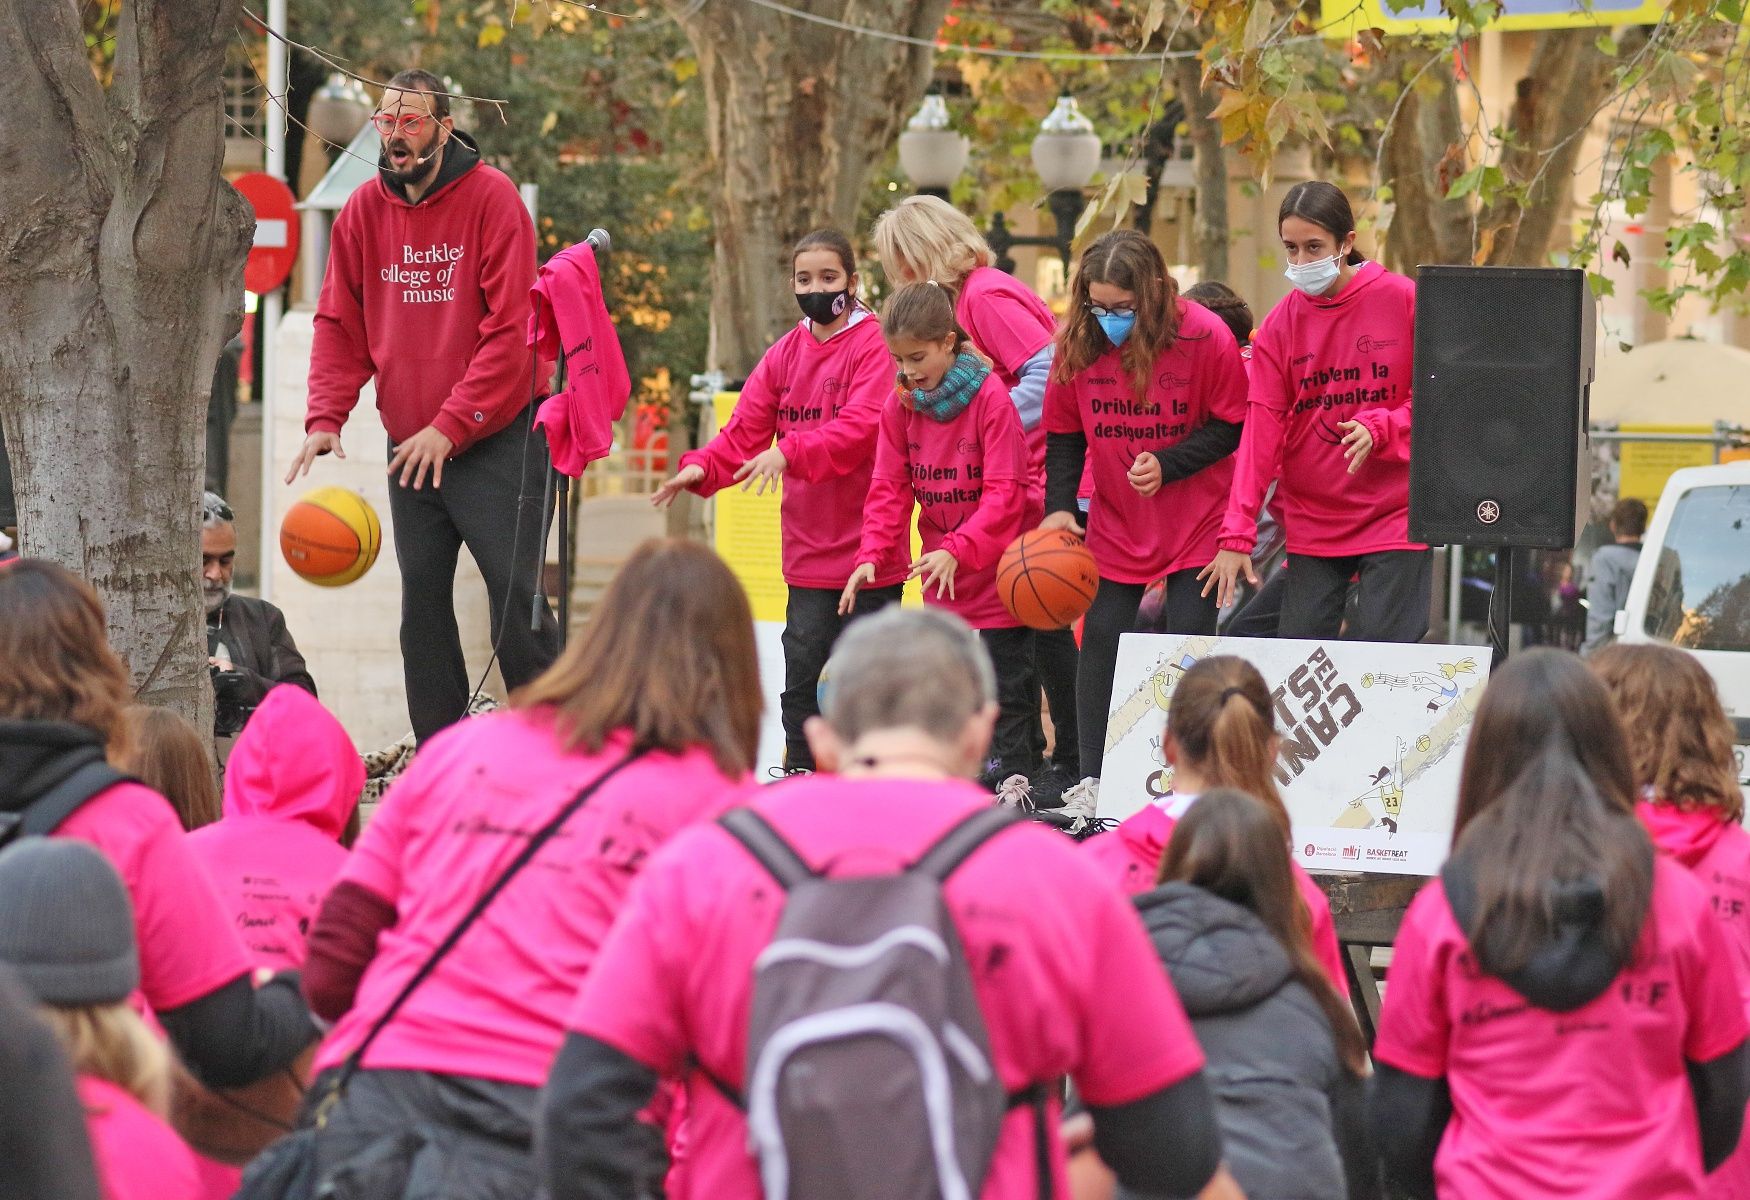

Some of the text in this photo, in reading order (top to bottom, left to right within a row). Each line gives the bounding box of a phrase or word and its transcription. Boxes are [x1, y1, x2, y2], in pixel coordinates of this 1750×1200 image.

[437, 262, 456, 287] of
[403, 287, 455, 303] music
[1301, 362, 1389, 391] riblem la
[1092, 398, 1188, 416] Driblem la
[1295, 384, 1397, 415] desgualtat!
[777, 404, 823, 422] riblem
[1095, 422, 1186, 442] desigualtat
[905, 462, 983, 480] iblem la
[915, 487, 983, 507] sigualta
[1307, 646, 1338, 692] PEL
[1385, 797, 1398, 807] 23
[1366, 849, 1408, 858] BASKETBEAT
